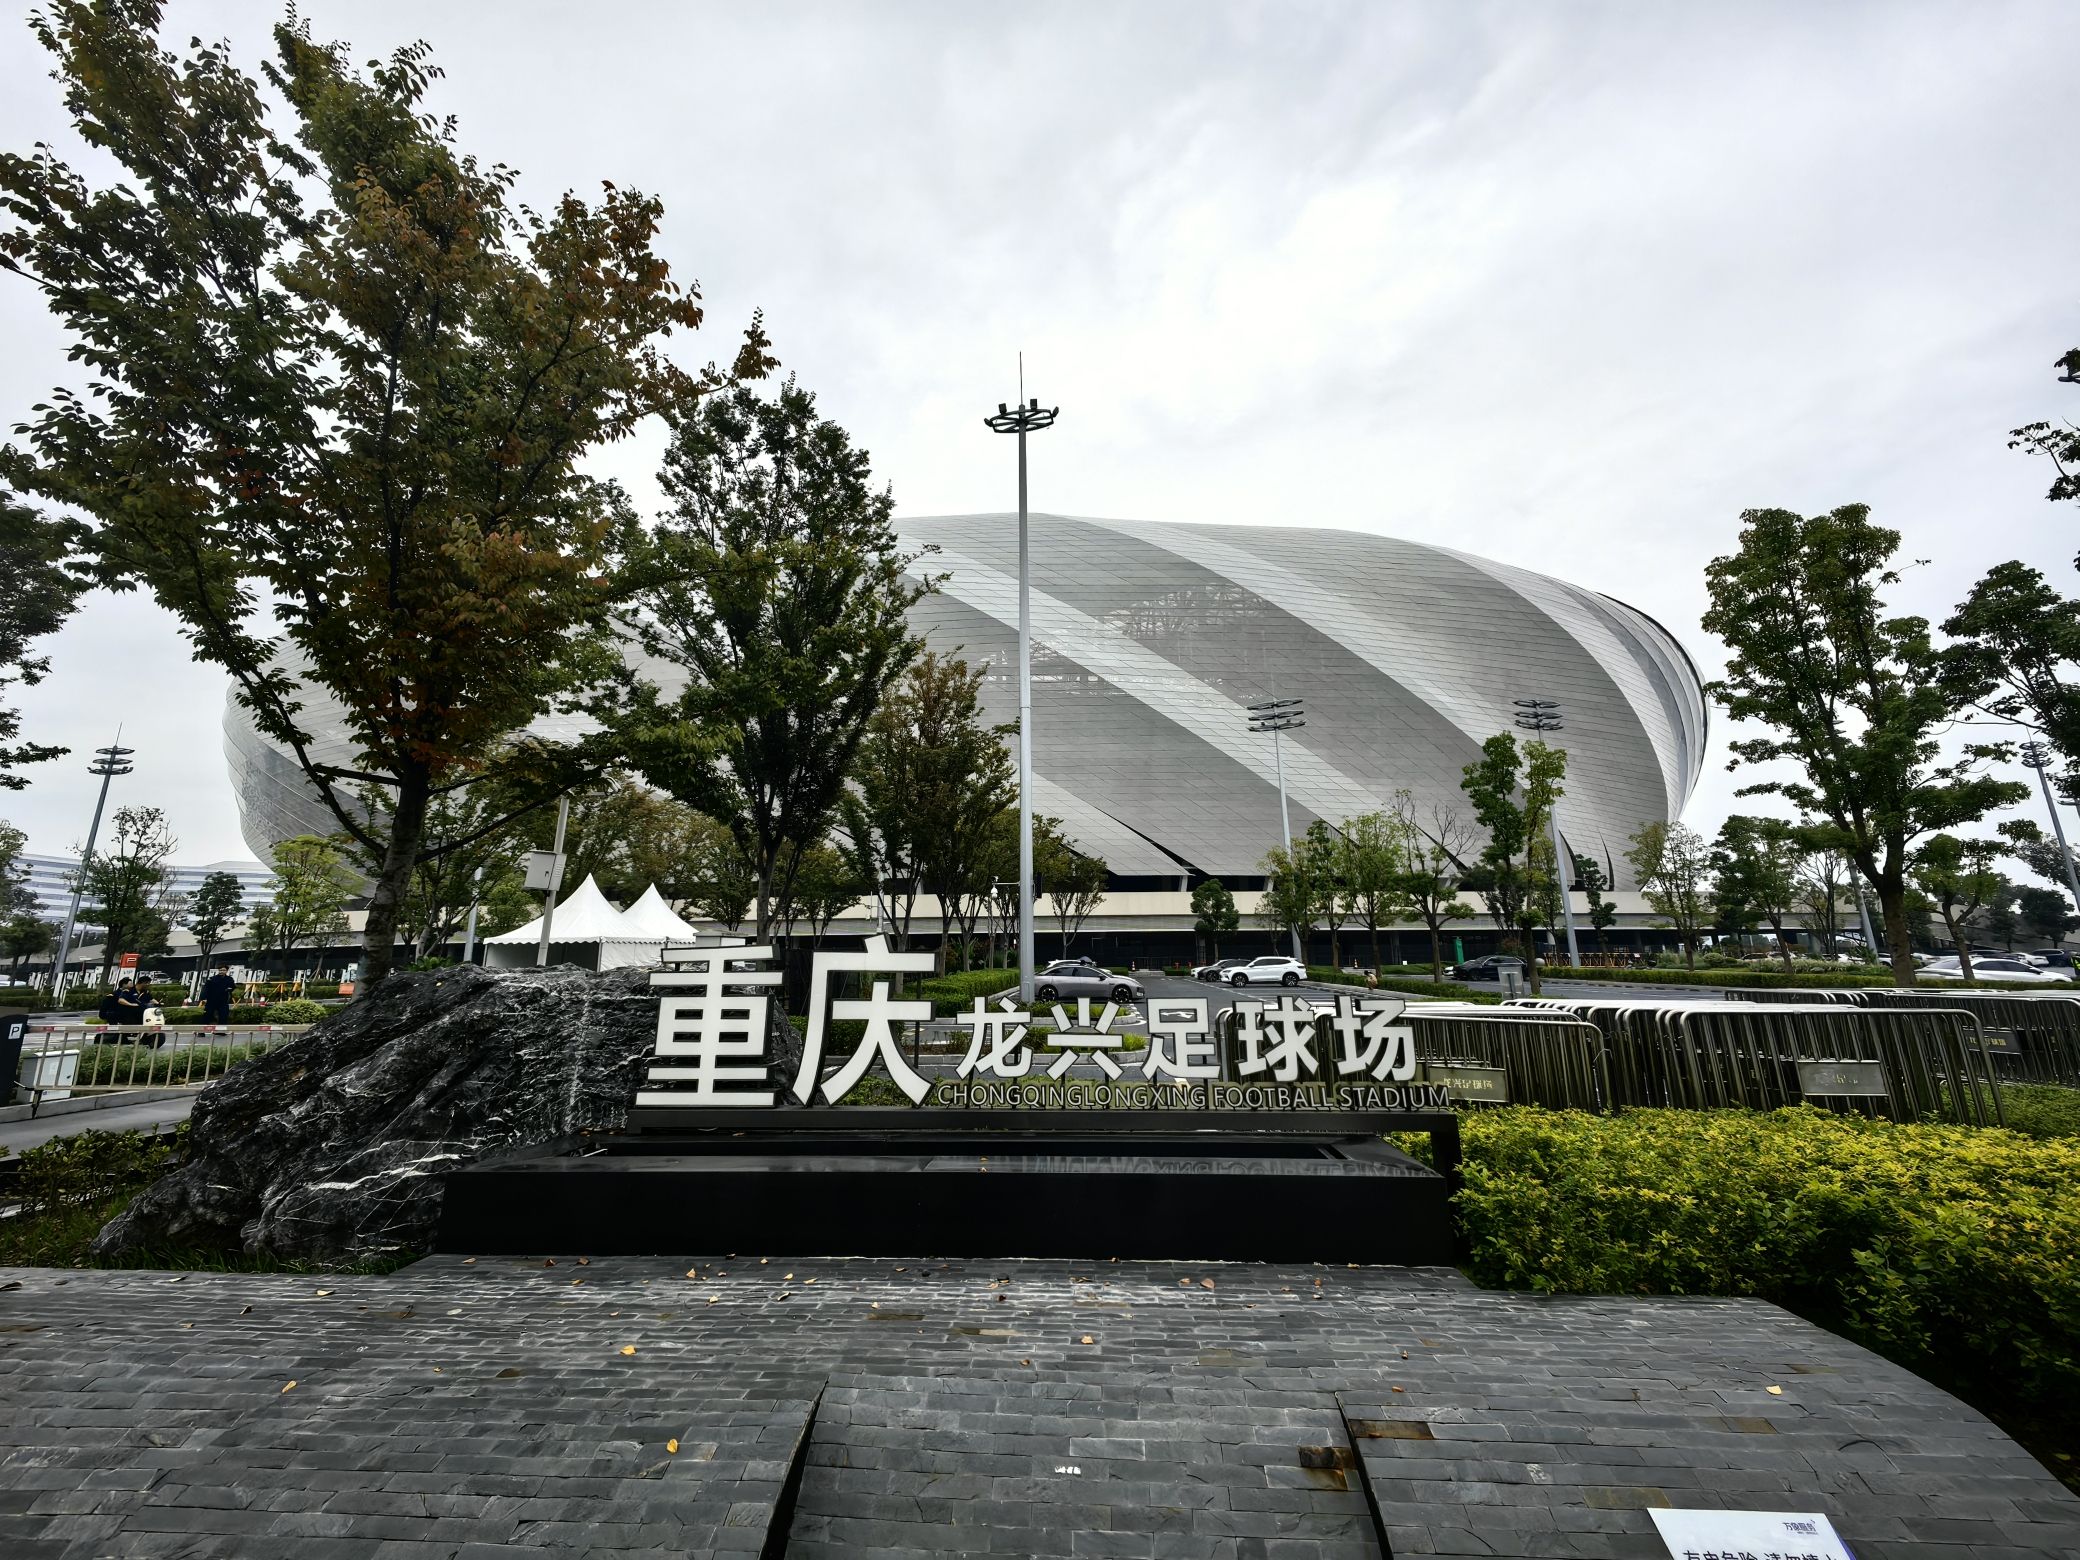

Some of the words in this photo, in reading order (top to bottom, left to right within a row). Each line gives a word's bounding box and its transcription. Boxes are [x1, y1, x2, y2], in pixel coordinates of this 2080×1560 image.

[11, 1026, 20, 1036] P
[633, 934, 937, 1107] 重庆
[954, 996, 1419, 1082] 龙兴足球场
[1213, 1086, 1334, 1108] FOOTBALL
[1339, 1086, 1450, 1107] STADIUM
